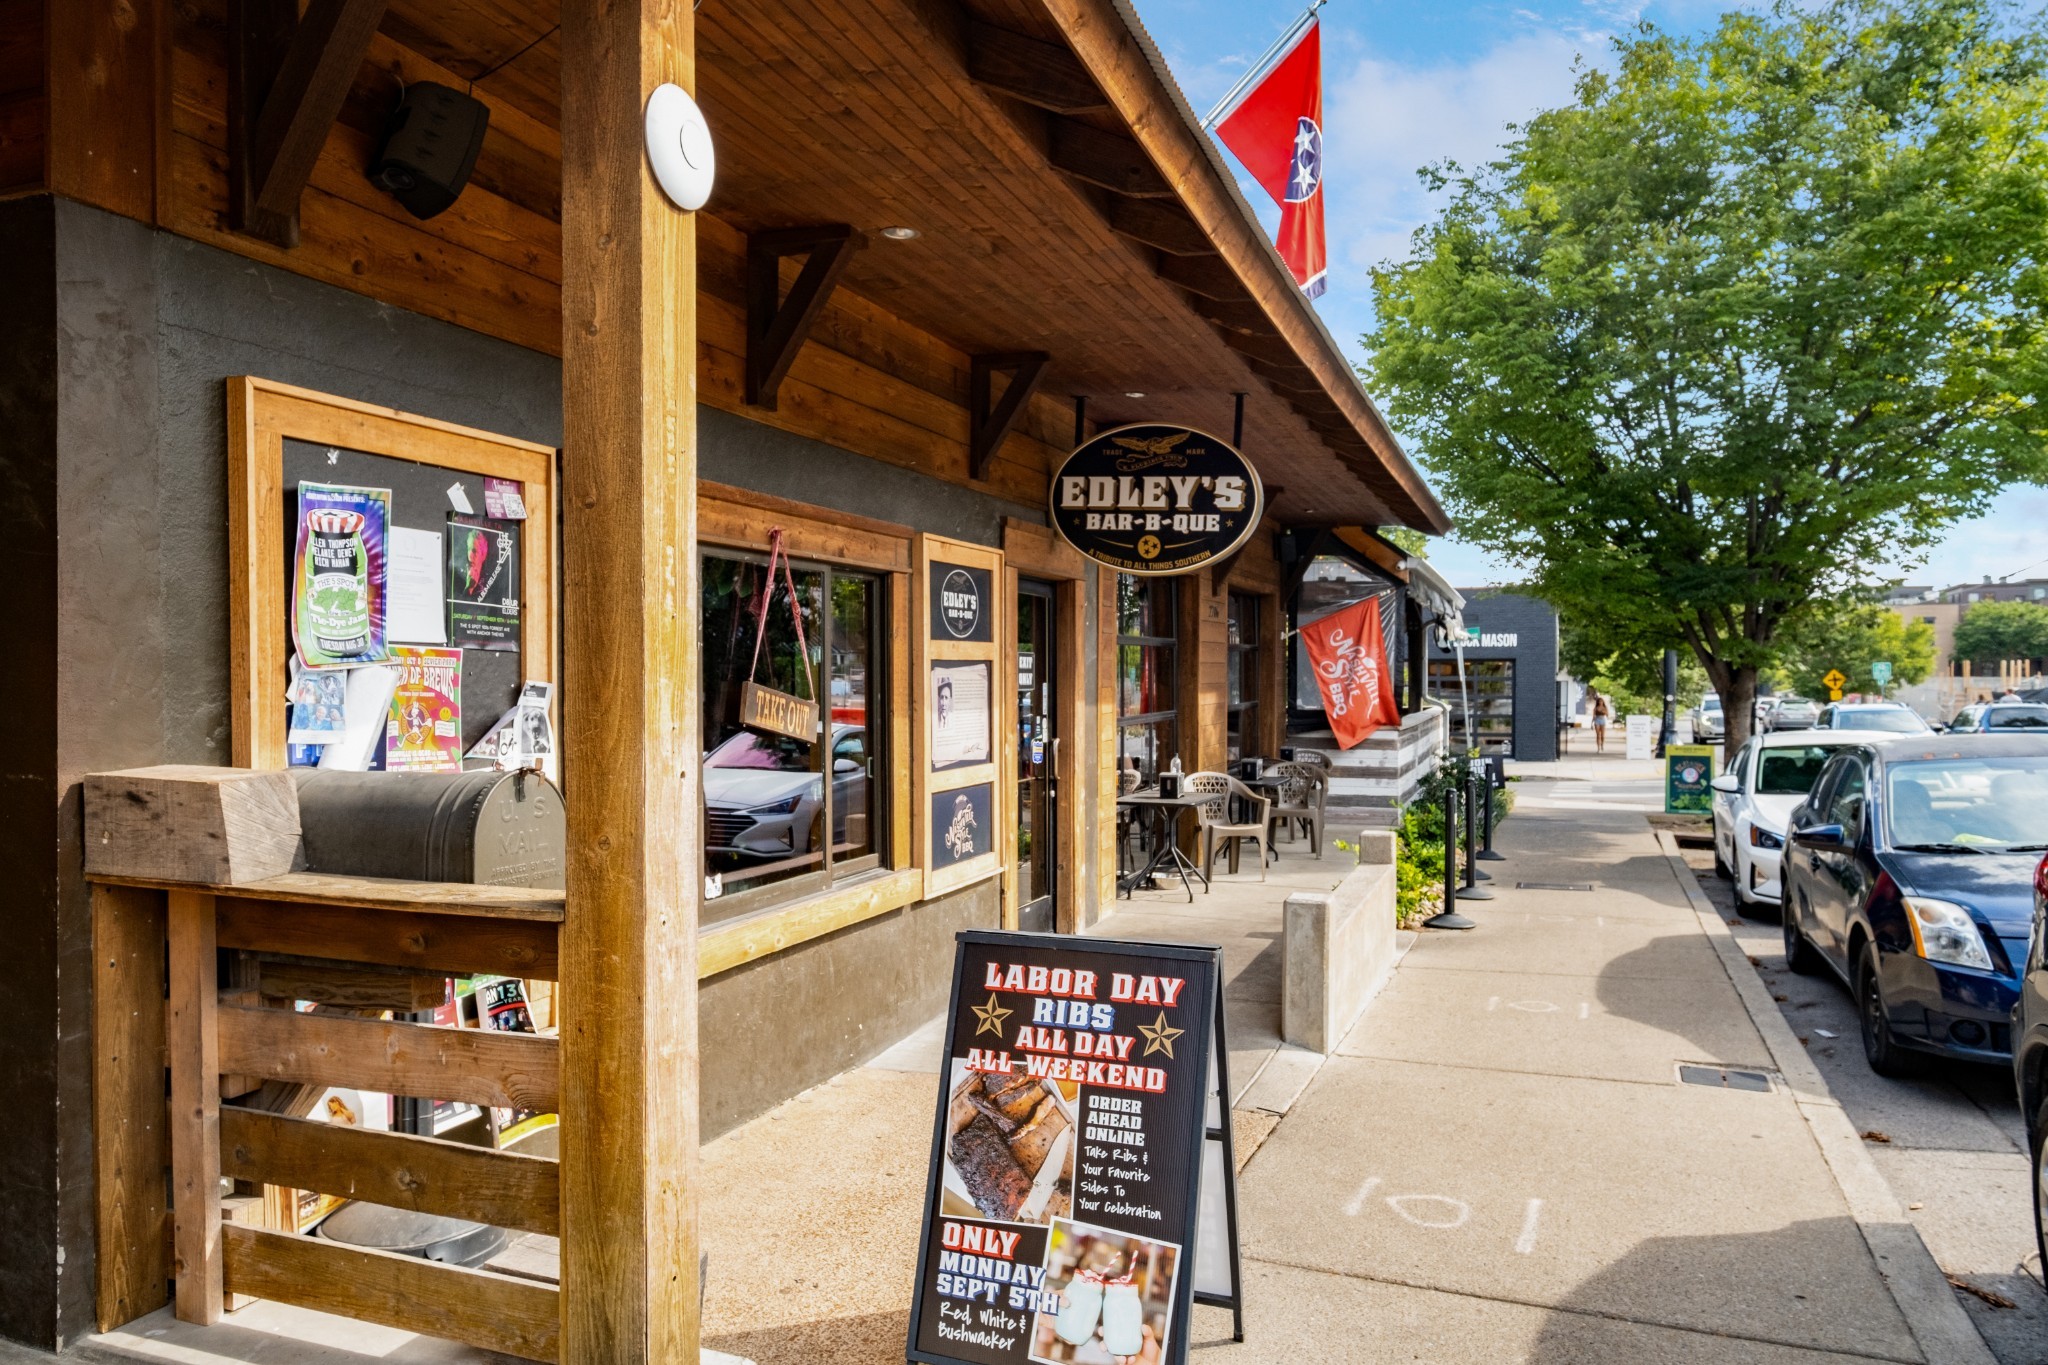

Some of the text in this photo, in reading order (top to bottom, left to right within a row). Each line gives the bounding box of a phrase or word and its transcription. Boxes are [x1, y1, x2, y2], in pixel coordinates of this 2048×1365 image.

[1060, 476, 1247, 511] EDLEY'S
[1095, 550, 1121, 566] TRIBUTE
[1123, 560, 1132, 568] TO
[1134, 561, 1146, 569] ALL
[1148, 561, 1173, 570] THINGS
[1175, 550, 1211, 568] SOUTHERN
[317, 580, 330, 588] THE
[336, 578, 355, 586] SPOT
[943, 591, 977, 610] EDLEY'S
[321, 637, 364, 651] TUESDAY AUG 30
[1481, 633, 1518, 648] MASON
[1019, 656, 1033, 669] EXIT
[410, 666, 421, 685] OF
[423, 666, 454, 703] BREWS
[1019, 672, 1033, 685] ONLY
[1329, 682, 1347, 719] BBQ
[756, 690, 809, 736] TAKE OUT
[498, 828, 548, 857] MAIL
[962, 841, 974, 853] BBQ
[984, 962, 1185, 1007] LABOR DAY
[1032, 997, 1116, 1032] RIBS
[1015, 1025, 1136, 1062] ALL DAY
[964, 1048, 1167, 1093] ALL WEEKEND
[1088, 1095, 1142, 1114] ORDER
[1087, 1110, 1142, 1130] AHEAD
[1085, 1126, 1145, 1146] ONLINE
[1084, 1146, 1108, 1159] Take
[1113, 1148, 1138, 1162] Ribs
[1082, 1162, 1151, 1182] Your Favorite
[1080, 1178, 1125, 1197] Sides To
[1079, 1197, 1161, 1220] Your Celebration
[942, 1221, 1021, 1260] ONLY
[939, 1250, 1046, 1290] MONDAY
[936, 1272, 1060, 1316] SEPT 5TH
[980, 1308, 1017, 1330] White
[938, 1320, 1015, 1351] Bushwacker
